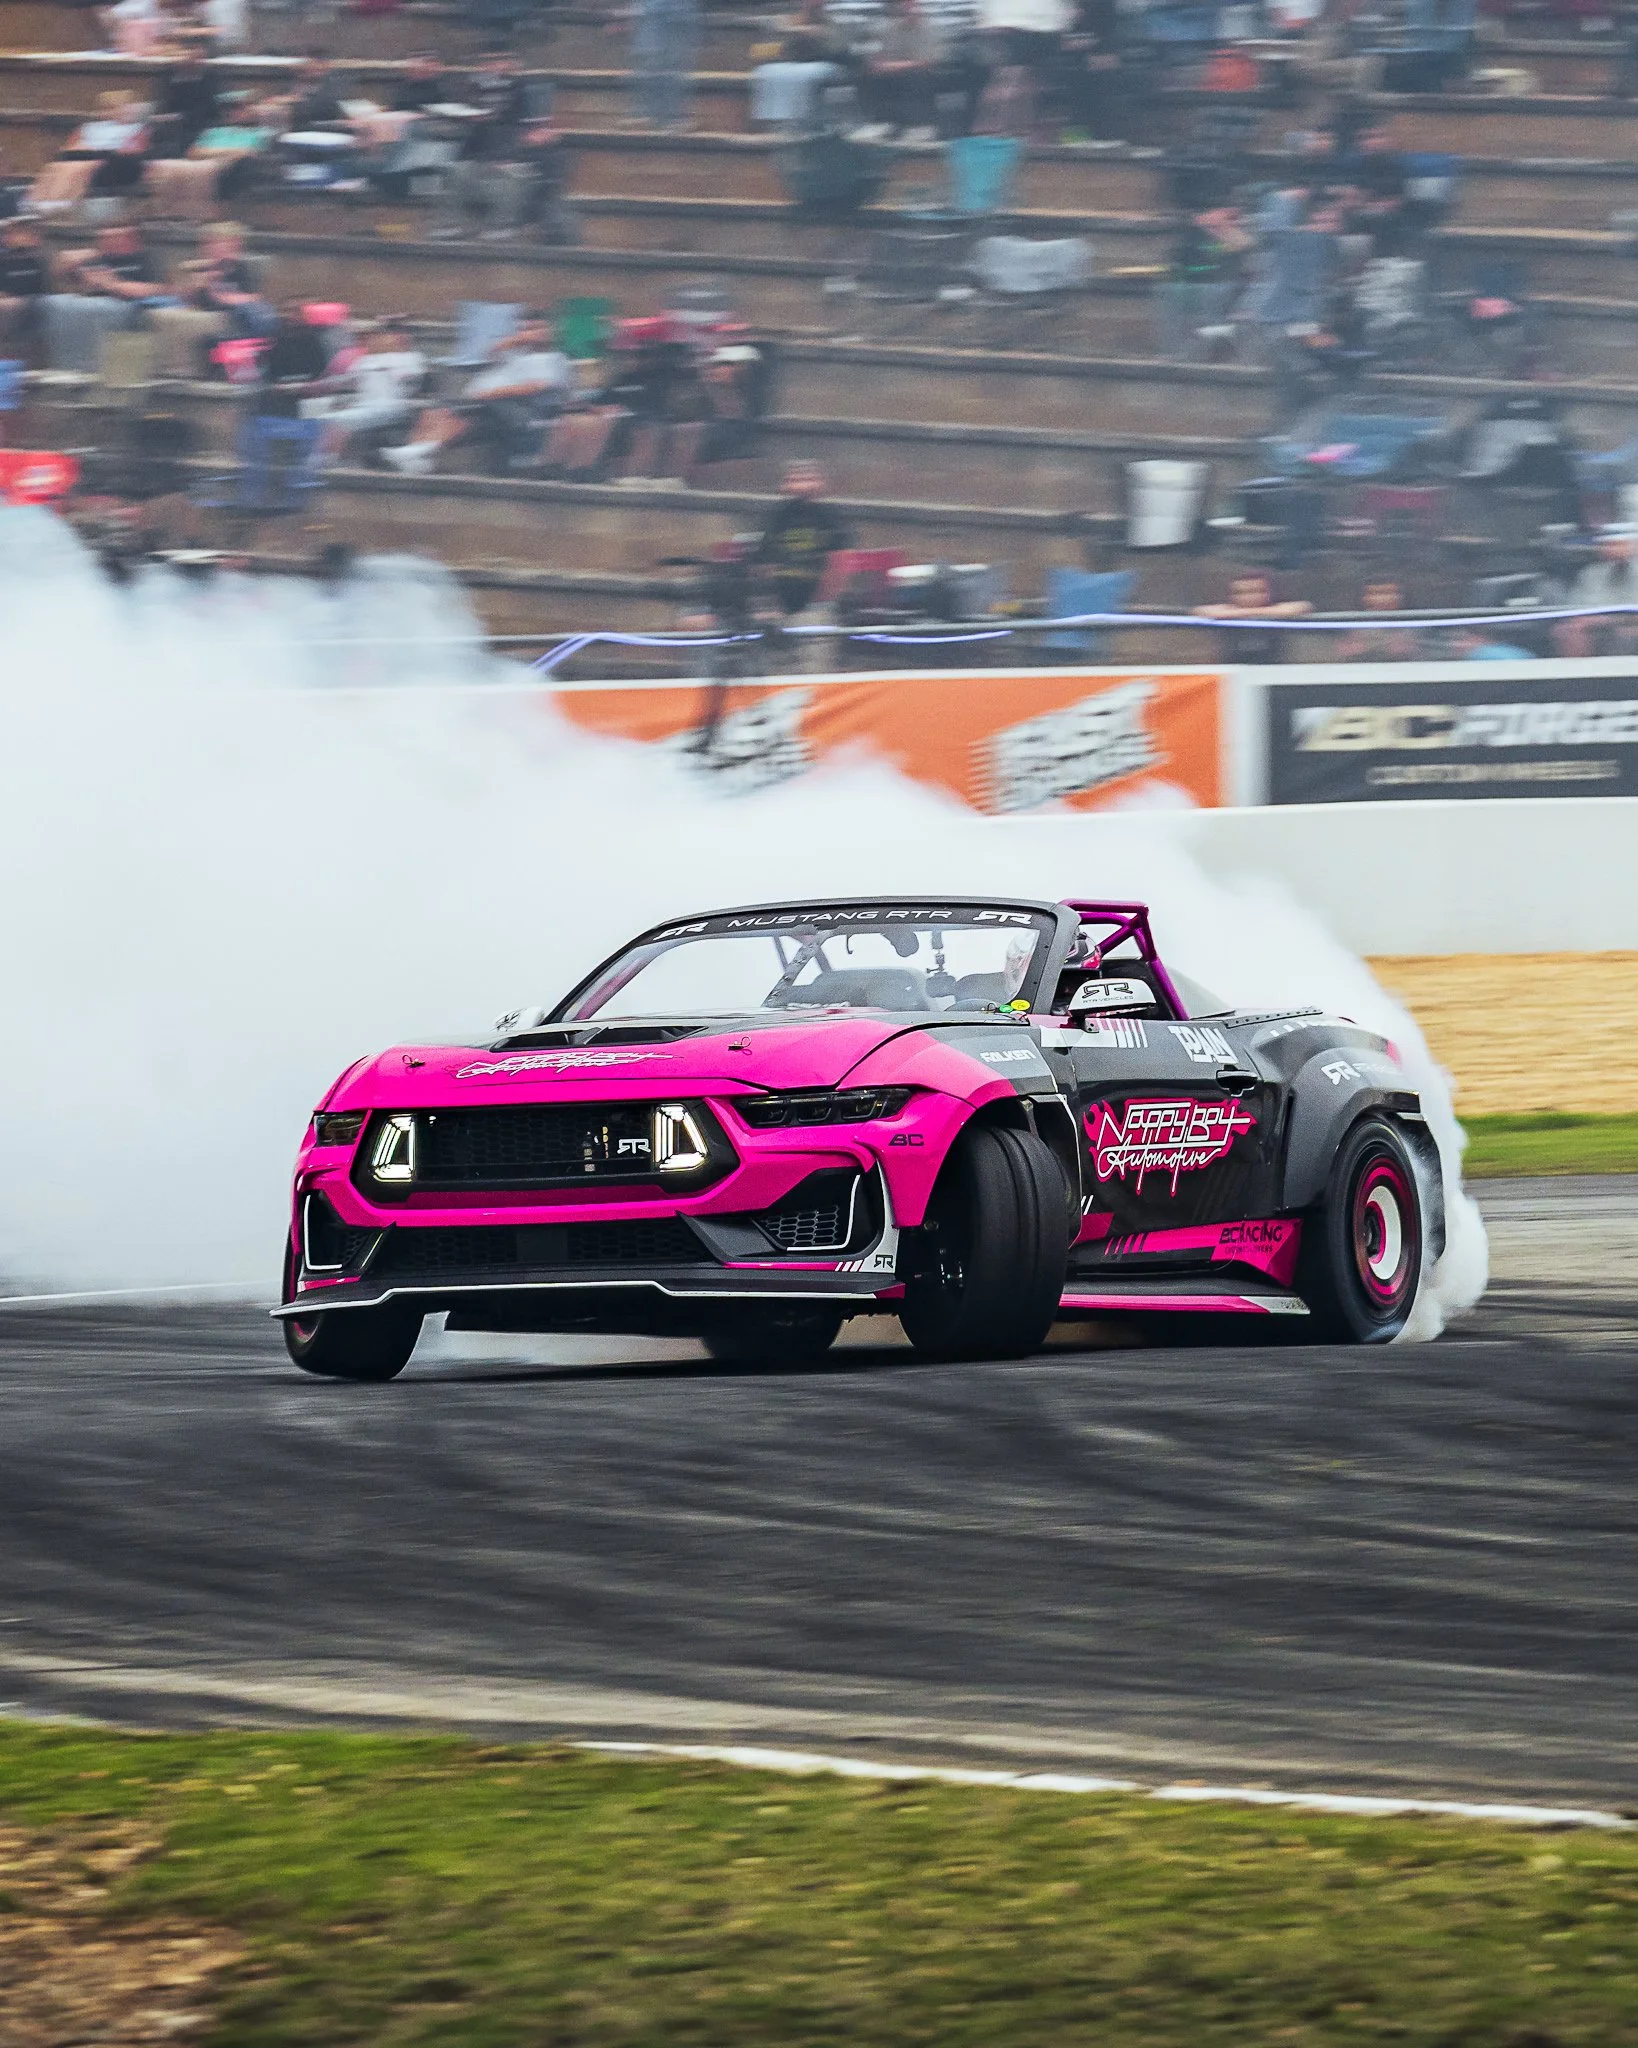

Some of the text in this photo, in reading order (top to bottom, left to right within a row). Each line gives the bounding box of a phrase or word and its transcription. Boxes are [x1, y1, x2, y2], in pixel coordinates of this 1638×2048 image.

[727, 910, 953, 928] MUSTANG RTR
[973, 911, 1032, 924] RTR
[1081, 982, 1134, 999] RTR
[616, 1138, 652, 1155] RTR
[888, 1133, 925, 1147] BC
[873, 1254, 894, 1269] RTR
